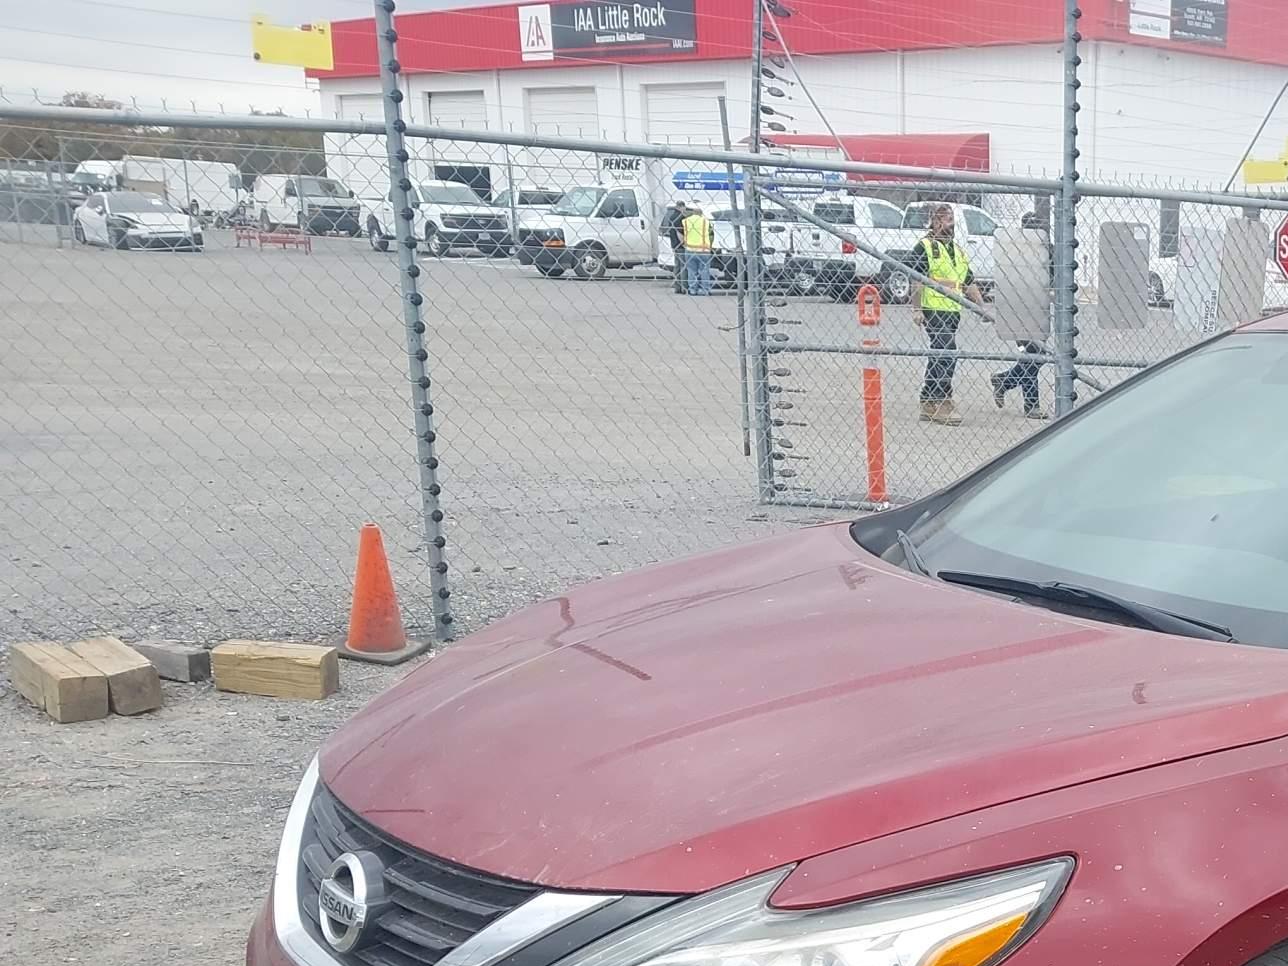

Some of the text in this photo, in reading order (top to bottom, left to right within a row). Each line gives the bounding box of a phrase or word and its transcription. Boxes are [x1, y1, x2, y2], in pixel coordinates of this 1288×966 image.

[574, 2, 666, 32] IAA Little Rock
[603, 158, 641, 170] PENSKE
[322, 893, 354, 921] SSAN
